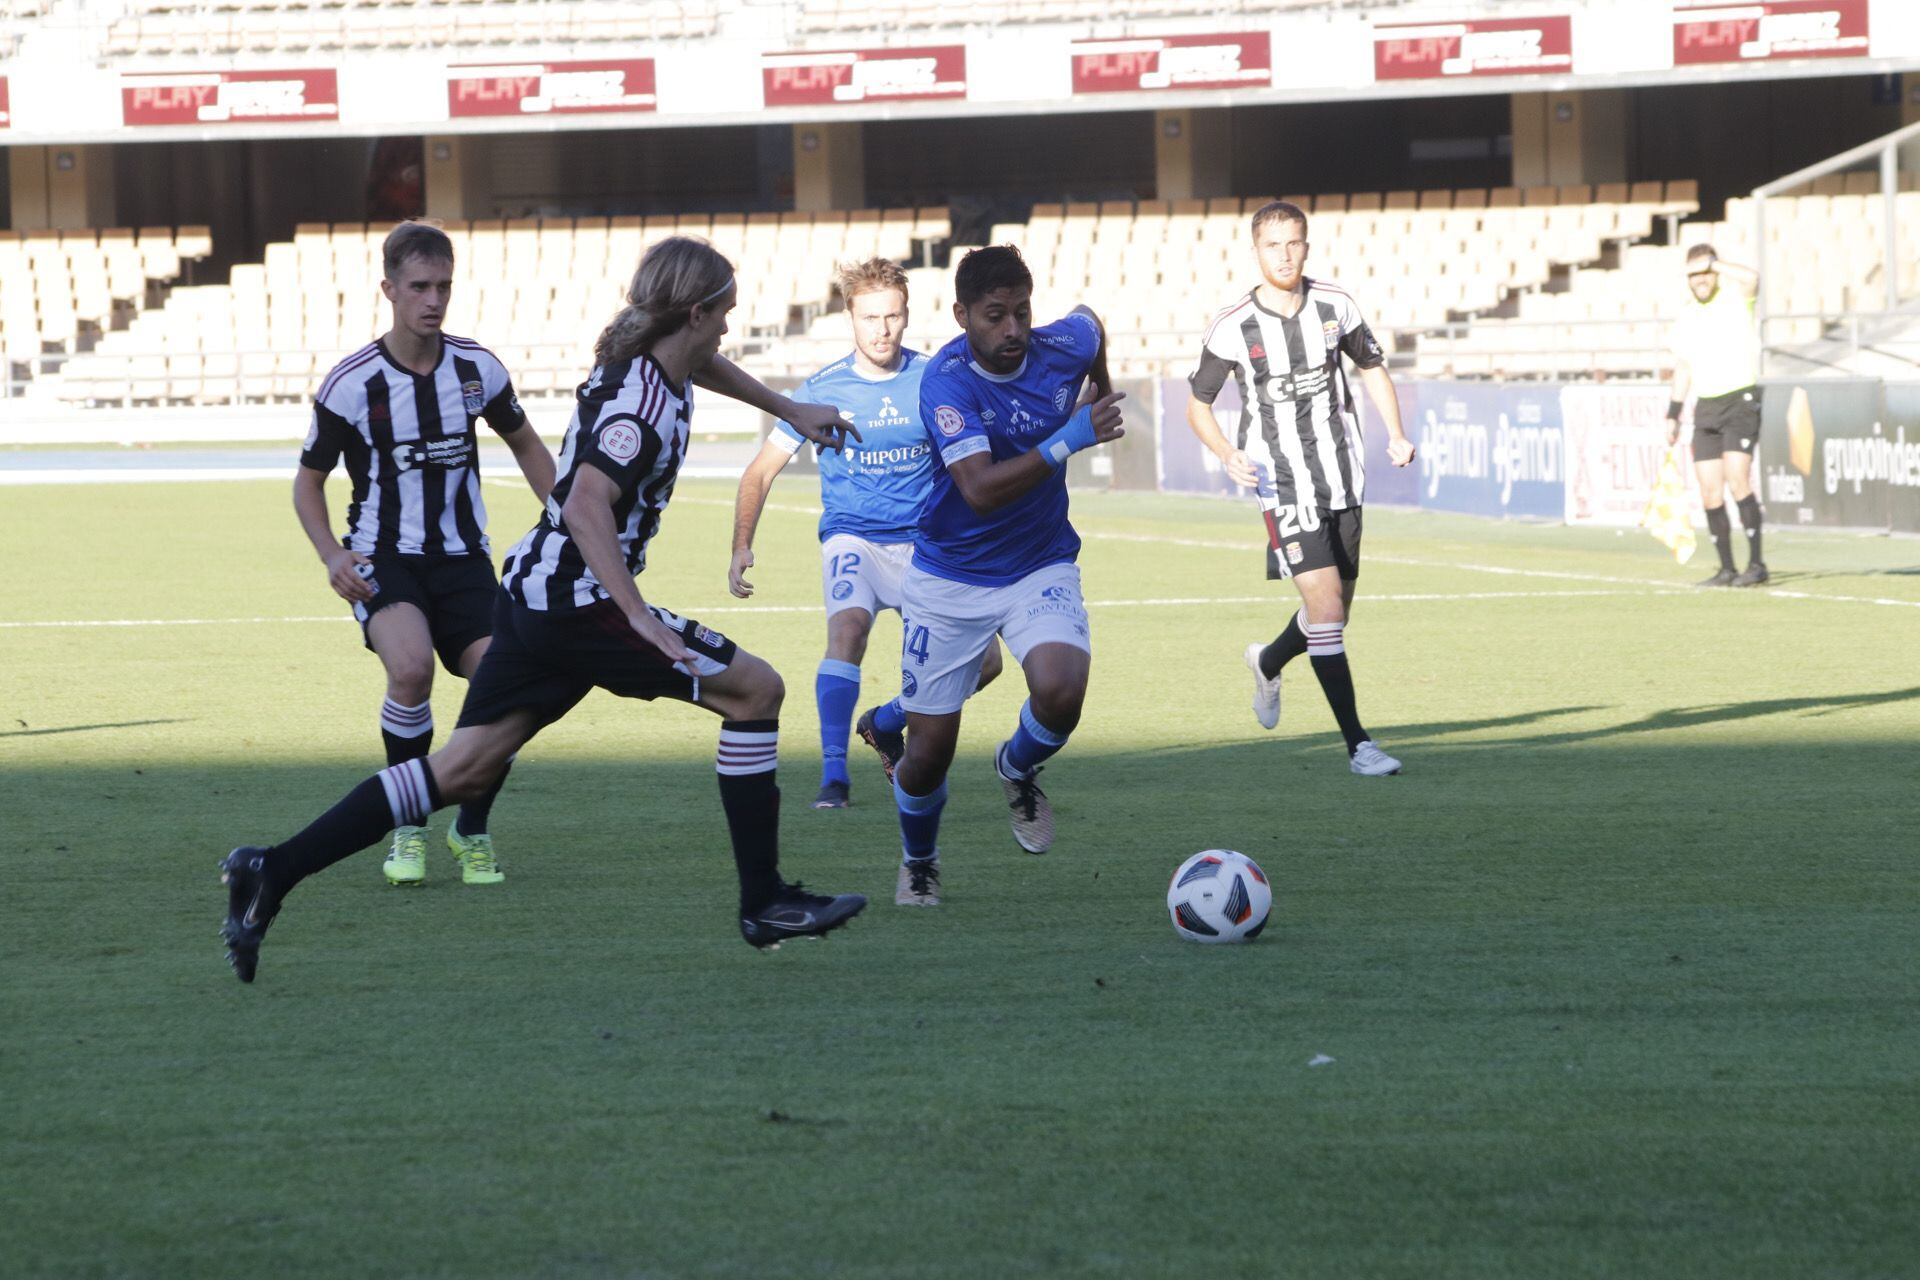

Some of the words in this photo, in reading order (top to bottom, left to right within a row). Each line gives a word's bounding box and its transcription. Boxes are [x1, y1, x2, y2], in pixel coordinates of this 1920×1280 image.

[1682, 20, 1755, 47] PLAY
[1383, 36, 1458, 63] PLAY
[1080, 50, 1155, 77] PLAY
[457, 76, 535, 102] PLAY
[772, 64, 848, 90] PLAY
[132, 85, 210, 109] PLAY
[868, 419, 885, 429] TIO
[887, 417, 911, 426] PEPE
[1020, 418, 1046, 433] PEPE
[1275, 503, 1320, 538] 20
[830, 552, 861, 577] 12
